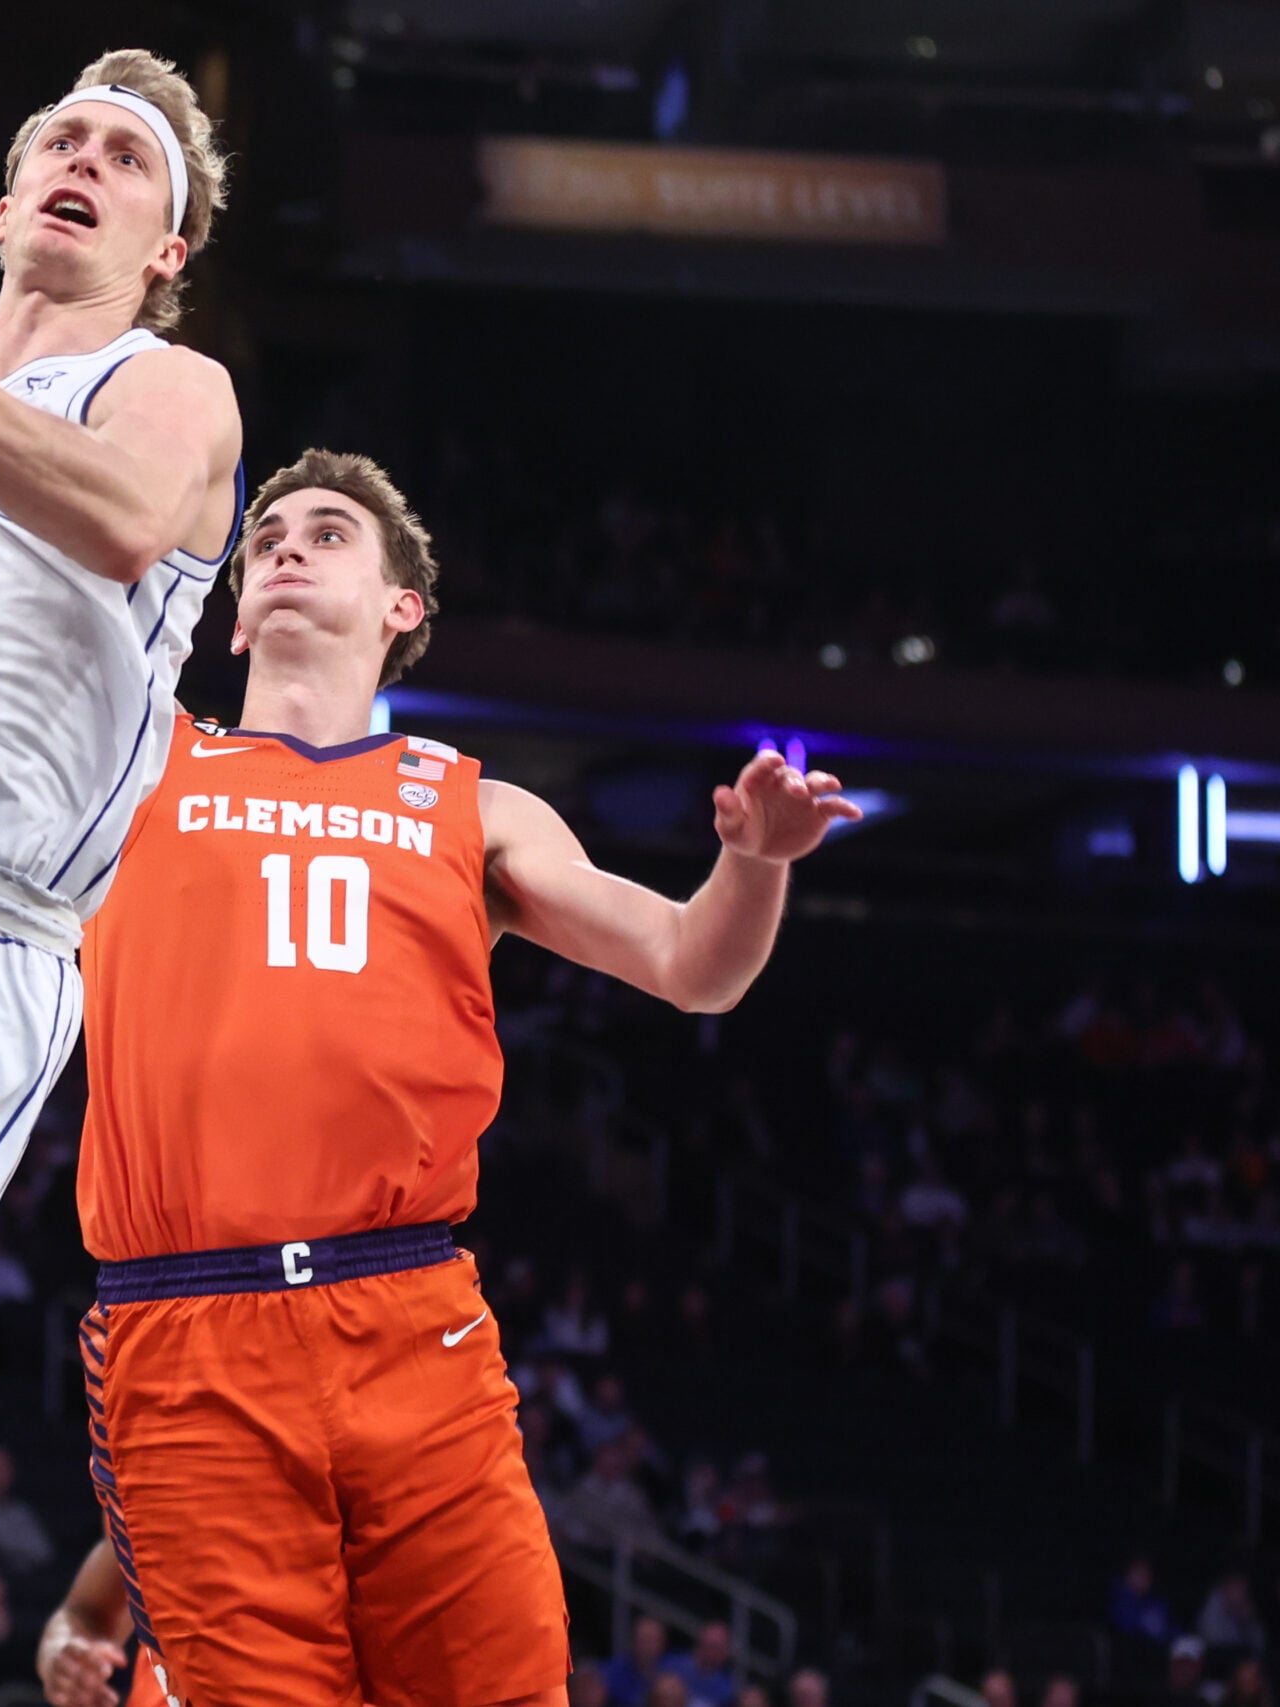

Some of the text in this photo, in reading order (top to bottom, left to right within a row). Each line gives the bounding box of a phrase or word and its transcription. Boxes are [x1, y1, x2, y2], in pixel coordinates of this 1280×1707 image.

[177, 794, 434, 857] CLEMSON
[260, 853, 370, 974] 10
[281, 1241, 313, 1285] C
